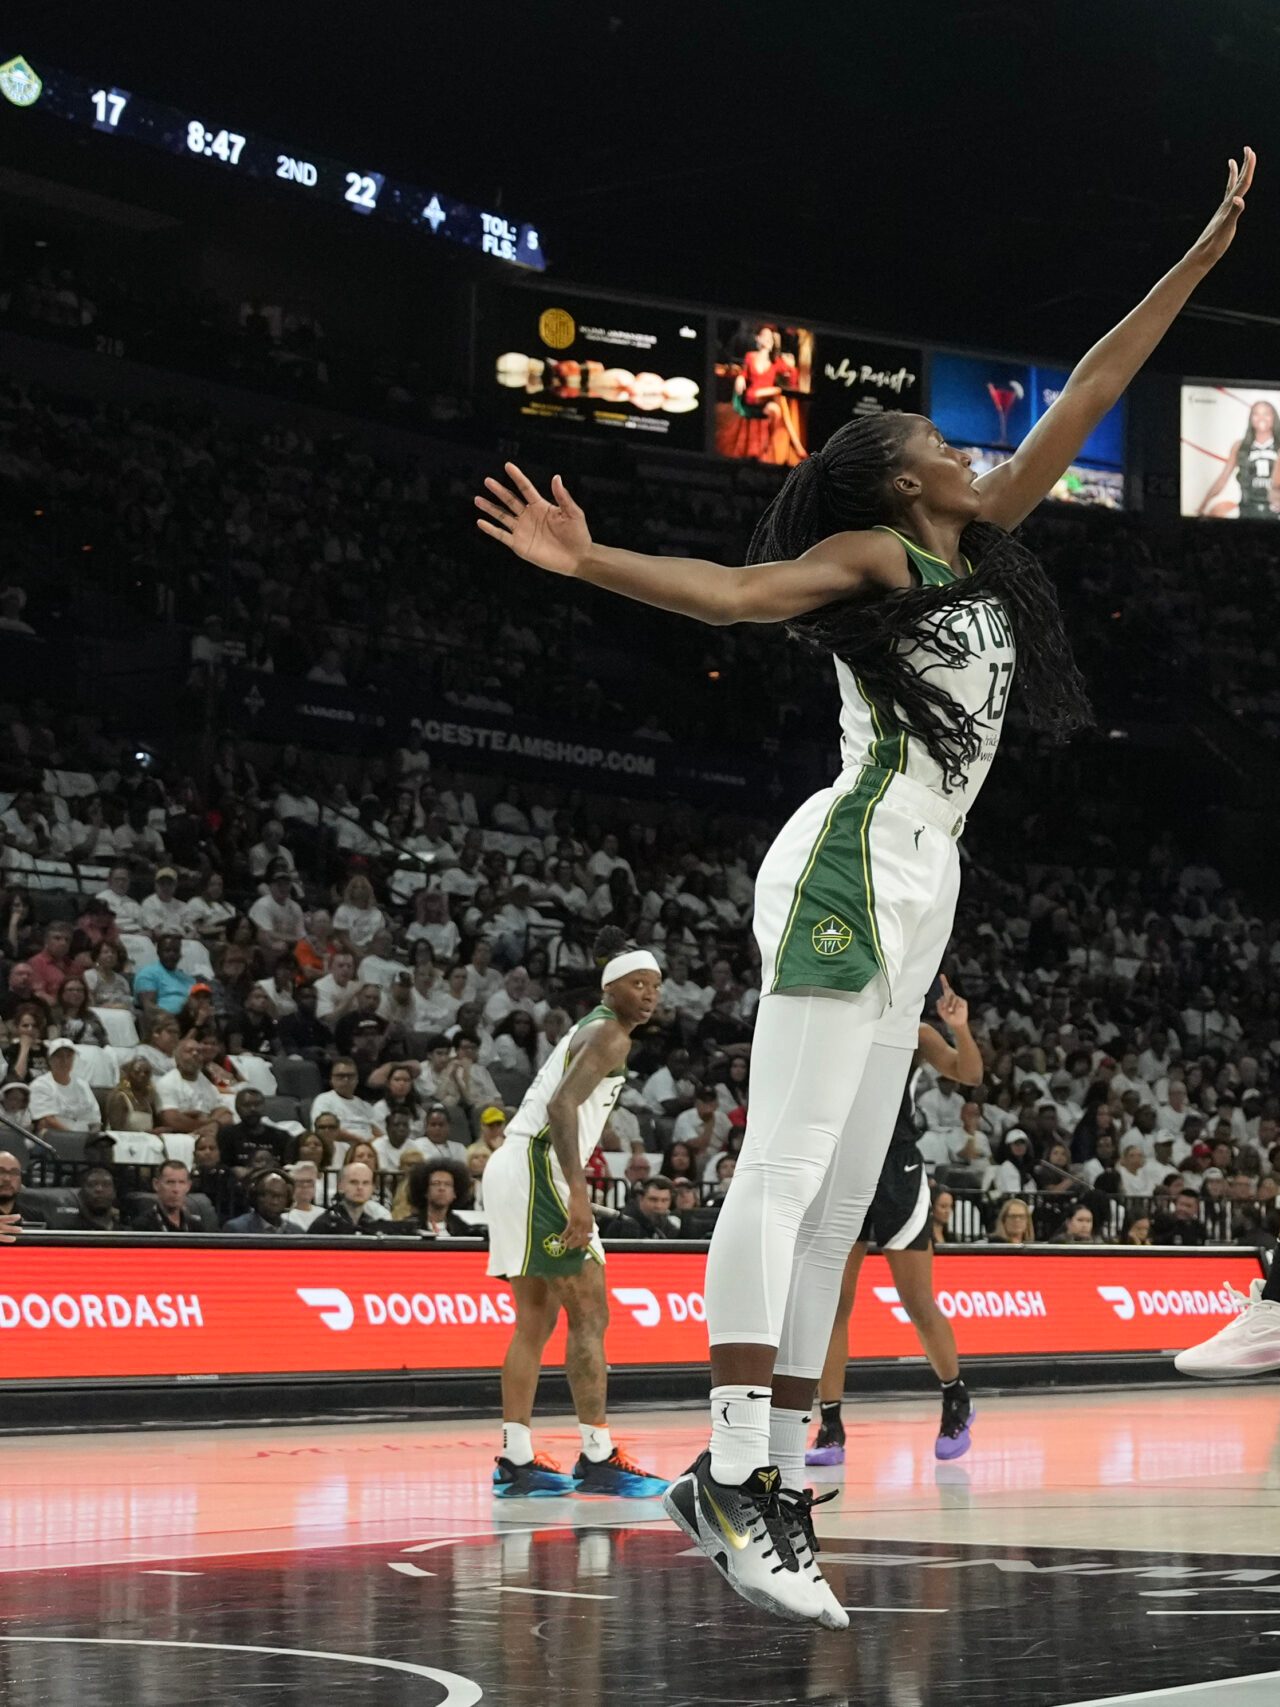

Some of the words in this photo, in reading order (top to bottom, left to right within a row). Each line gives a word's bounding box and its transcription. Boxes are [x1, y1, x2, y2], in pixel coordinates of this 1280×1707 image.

[91, 90, 127, 127] 17
[187, 120, 246, 165] 8:47
[276, 155, 318, 187] 2ND
[344, 172, 377, 209] 22
[481, 212, 517, 242] TOL:
[482, 233, 517, 261] FLS:
[0, 1293, 204, 1329] DOORDASH
[363, 1292, 517, 1325] DOORDAS
[935, 1290, 1047, 1319] OORDASH
